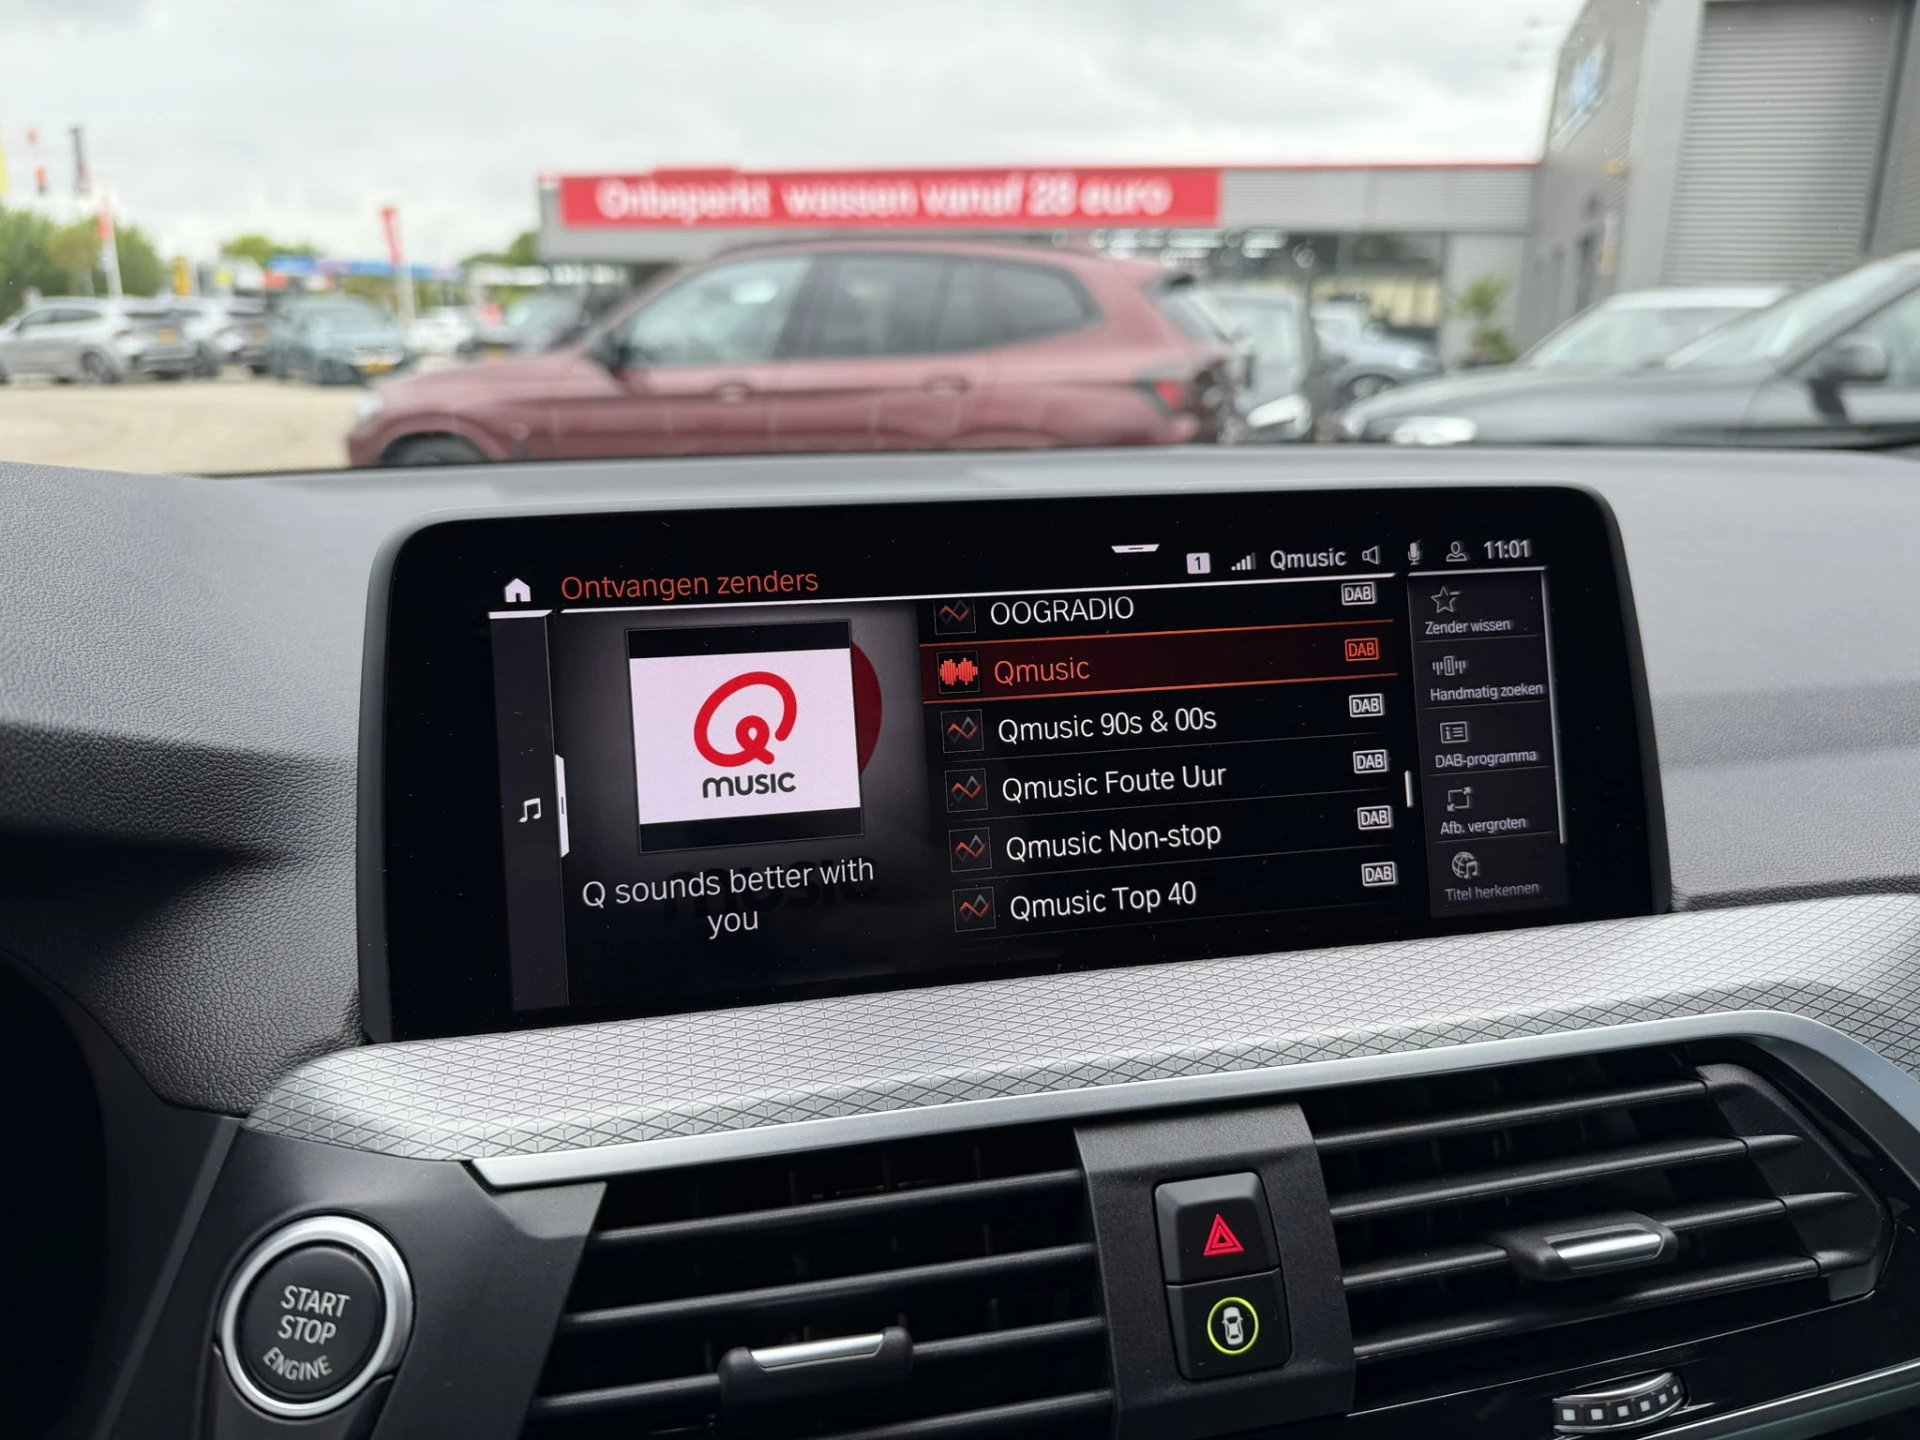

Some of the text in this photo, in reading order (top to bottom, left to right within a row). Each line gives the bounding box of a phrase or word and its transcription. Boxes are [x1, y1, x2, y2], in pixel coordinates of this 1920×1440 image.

[595, 170, 1174, 226] Onbeperkt wassen vanaf 28 euro
[1270, 548, 1347, 571] Qmusic
[1483, 539, 1532, 559] 11:01
[561, 570, 819, 601] Ontvangen zenders
[1344, 586, 1372, 601] DAB
[990, 596, 1135, 626] OOGRADIO
[1425, 619, 1511, 635] Zender wissen
[1348, 641, 1376, 657] DAB
[994, 657, 1090, 685] Qmusic
[1430, 683, 1543, 702] Handmatig zoeken
[1352, 697, 1380, 714] DAB
[999, 707, 1217, 744] Qmusic 90s & 00s
[1356, 753, 1384, 770] DAB
[1435, 750, 1537, 768] DAB-programma
[1002, 765, 1226, 803] Qmusic Foute Uur
[1361, 809, 1389, 826] DAB
[1440, 817, 1526, 835] Afb. vergroten
[1006, 823, 1222, 862] Qmusic Non-stop
[582, 857, 874, 909] Q sounds better with
[1365, 866, 1393, 882] DAB
[1010, 881, 1197, 922] Qmusic Top 40
[1445, 883, 1539, 901] Titel herkennen
[707, 911, 759, 940] you
[280, 1285, 351, 1318] START
[277, 1314, 336, 1346] STOP
[262, 1346, 333, 1381] ENGINE
